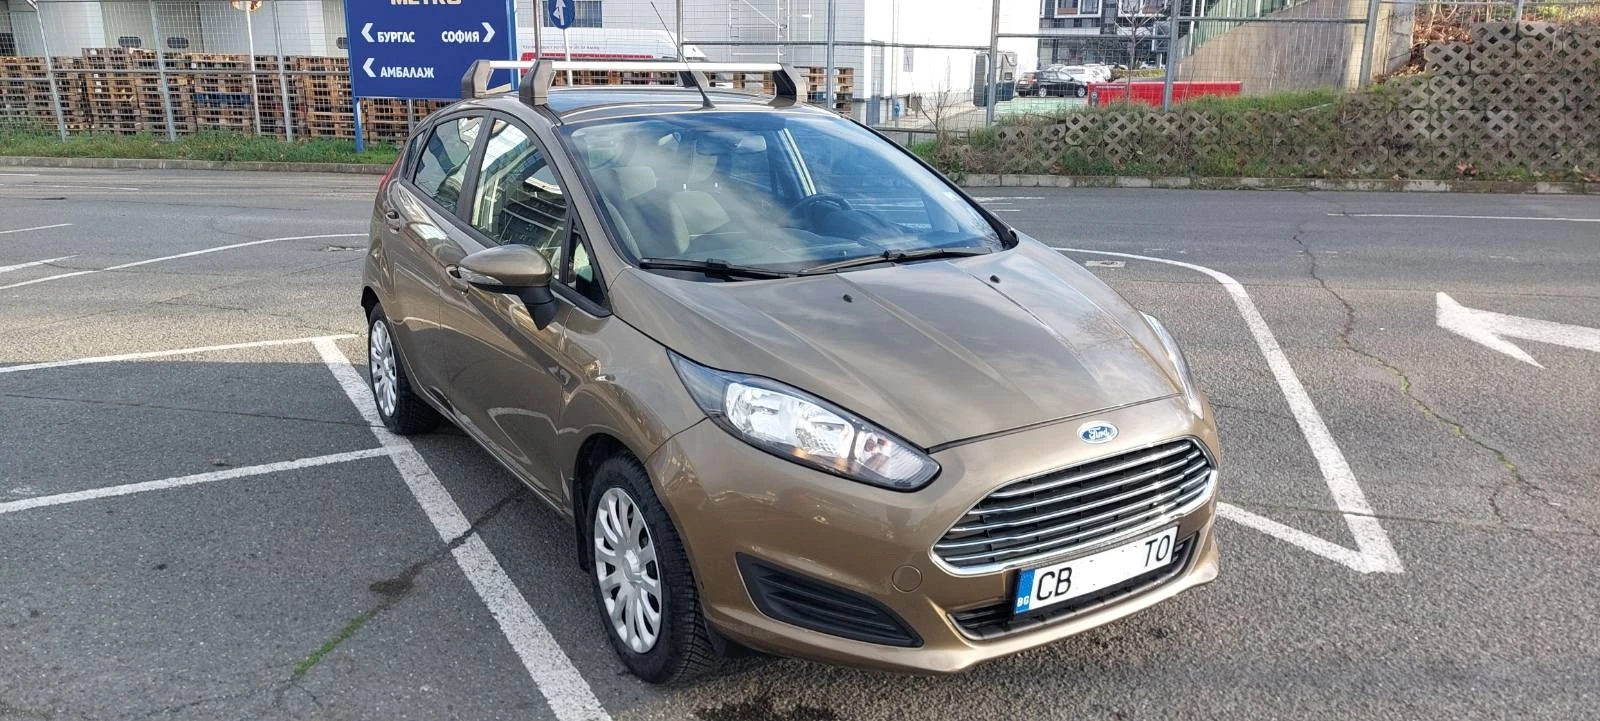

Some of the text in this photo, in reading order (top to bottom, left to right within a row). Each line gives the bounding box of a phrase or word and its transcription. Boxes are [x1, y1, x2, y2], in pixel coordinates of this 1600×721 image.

[377, 32, 415, 43] БУРГАС
[441, 30, 480, 44] СОФИЯ
[380, 67, 435, 78] АМБАЛАЖ
[1087, 426, 1111, 440] Ford
[1016, 595, 1030, 607] BG
